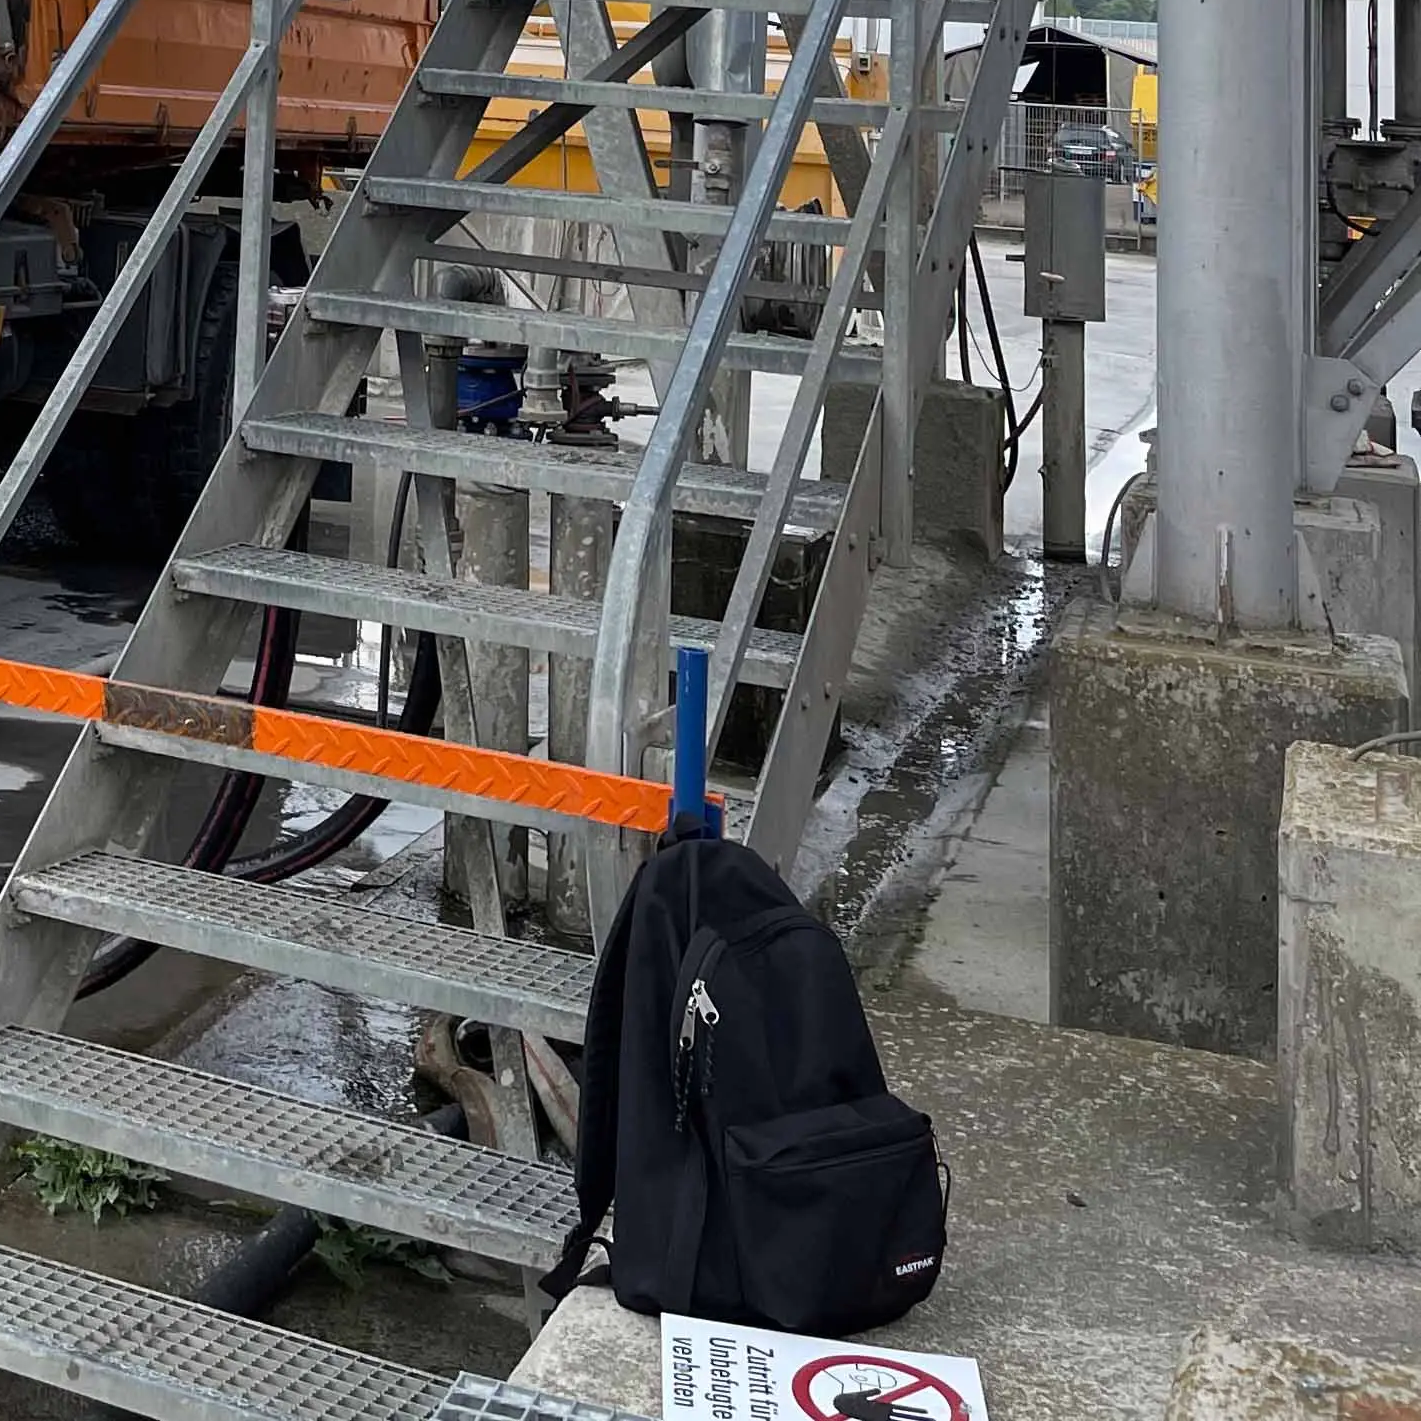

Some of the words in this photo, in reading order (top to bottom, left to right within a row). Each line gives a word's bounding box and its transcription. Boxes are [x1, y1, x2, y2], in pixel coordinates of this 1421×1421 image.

[895, 1256, 936, 1276] EASTPAK
[672, 1337, 701, 1408] verboten
[704, 1337, 739, 1420] Unbefugte
[746, 1345, 777, 1396] Zutritt
